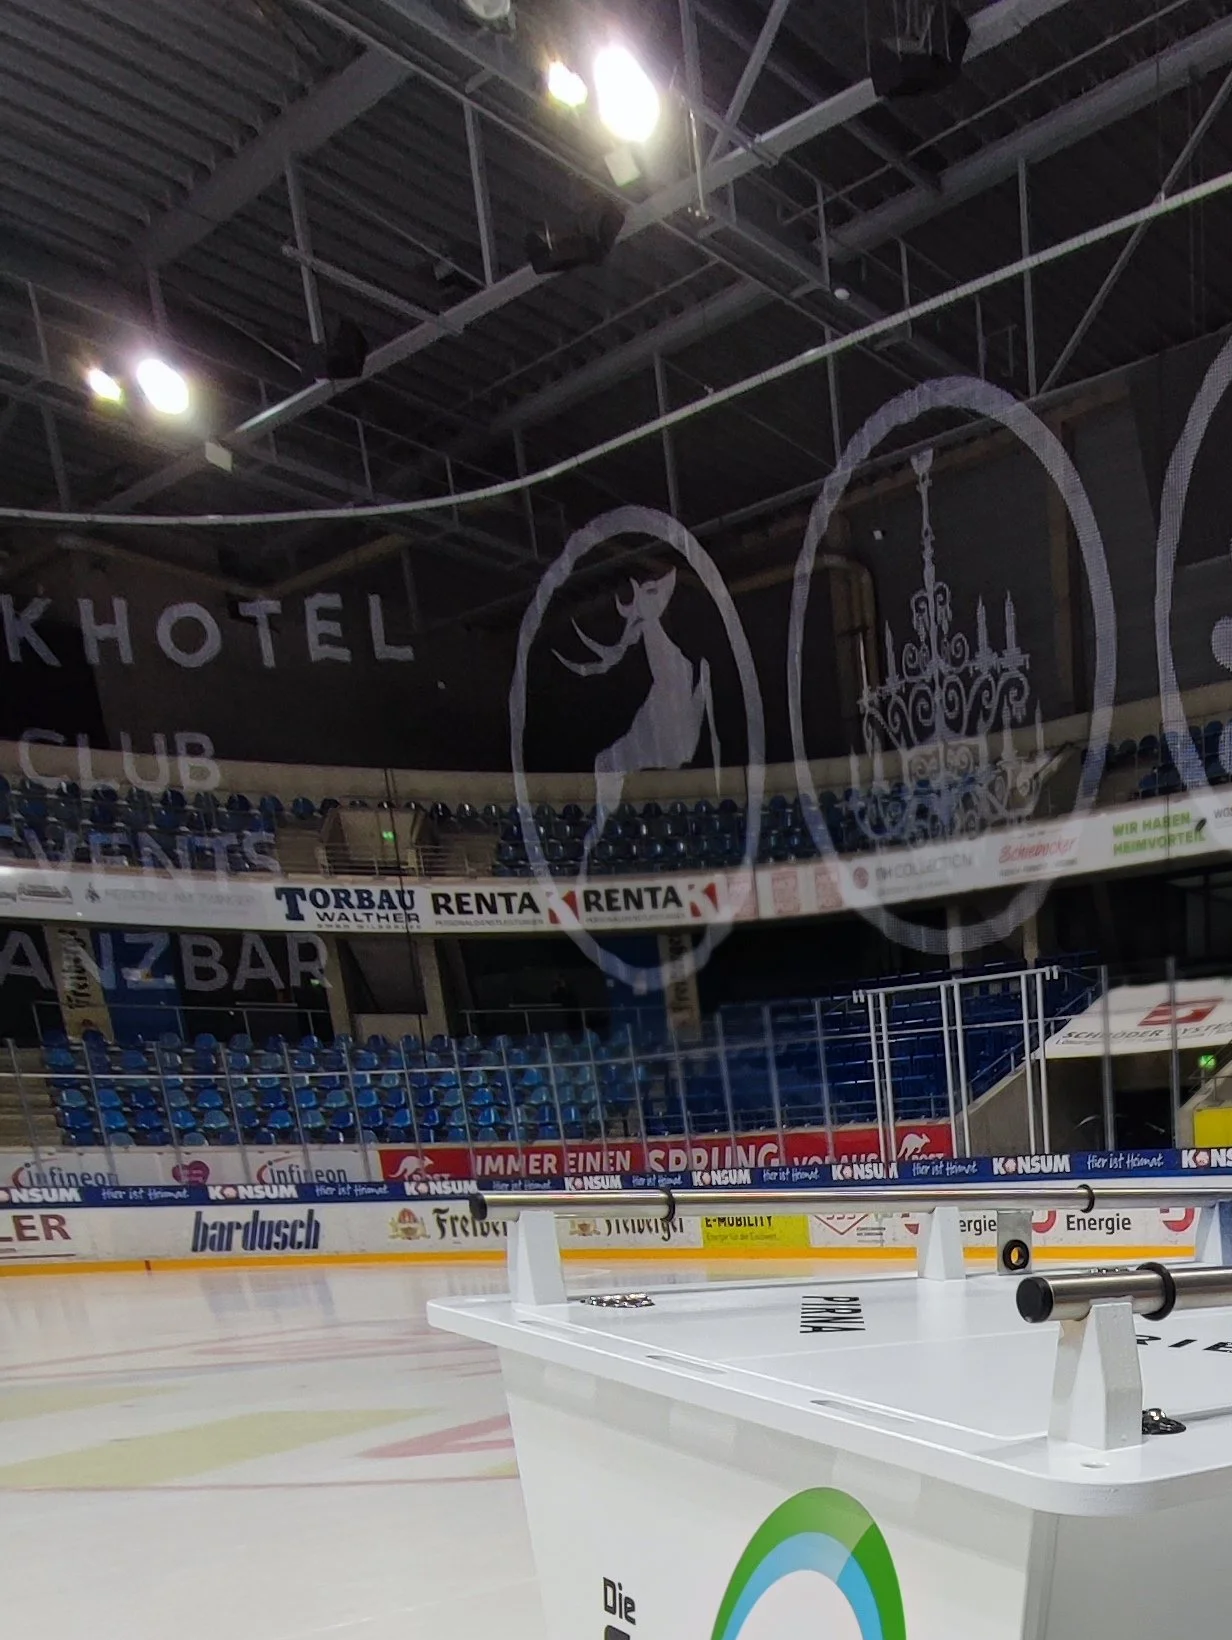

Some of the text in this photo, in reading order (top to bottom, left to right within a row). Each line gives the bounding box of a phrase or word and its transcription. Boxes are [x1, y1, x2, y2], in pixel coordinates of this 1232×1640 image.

[18, 728, 221, 792] CLUB
[1112, 820, 1139, 838] WIR
[1142, 812, 1192, 833] HABEN
[0, 824, 285, 893] VENTS
[274, 886, 415, 922] TORBAU
[430, 891, 541, 916] RENTA
[582, 885, 684, 913] RENTA
[315, 911, 421, 924] WALTHER
[476, 1153, 558, 1176] IMMER
[566, 1149, 632, 1174] EINEN
[1086, 1154, 1108, 1170] Hier
[191, 1208, 321, 1252] bardusch
[959, 1214, 997, 1237] ergie
[1065, 1212, 1132, 1235] Energie
[602, 1576, 637, 1626] Die
